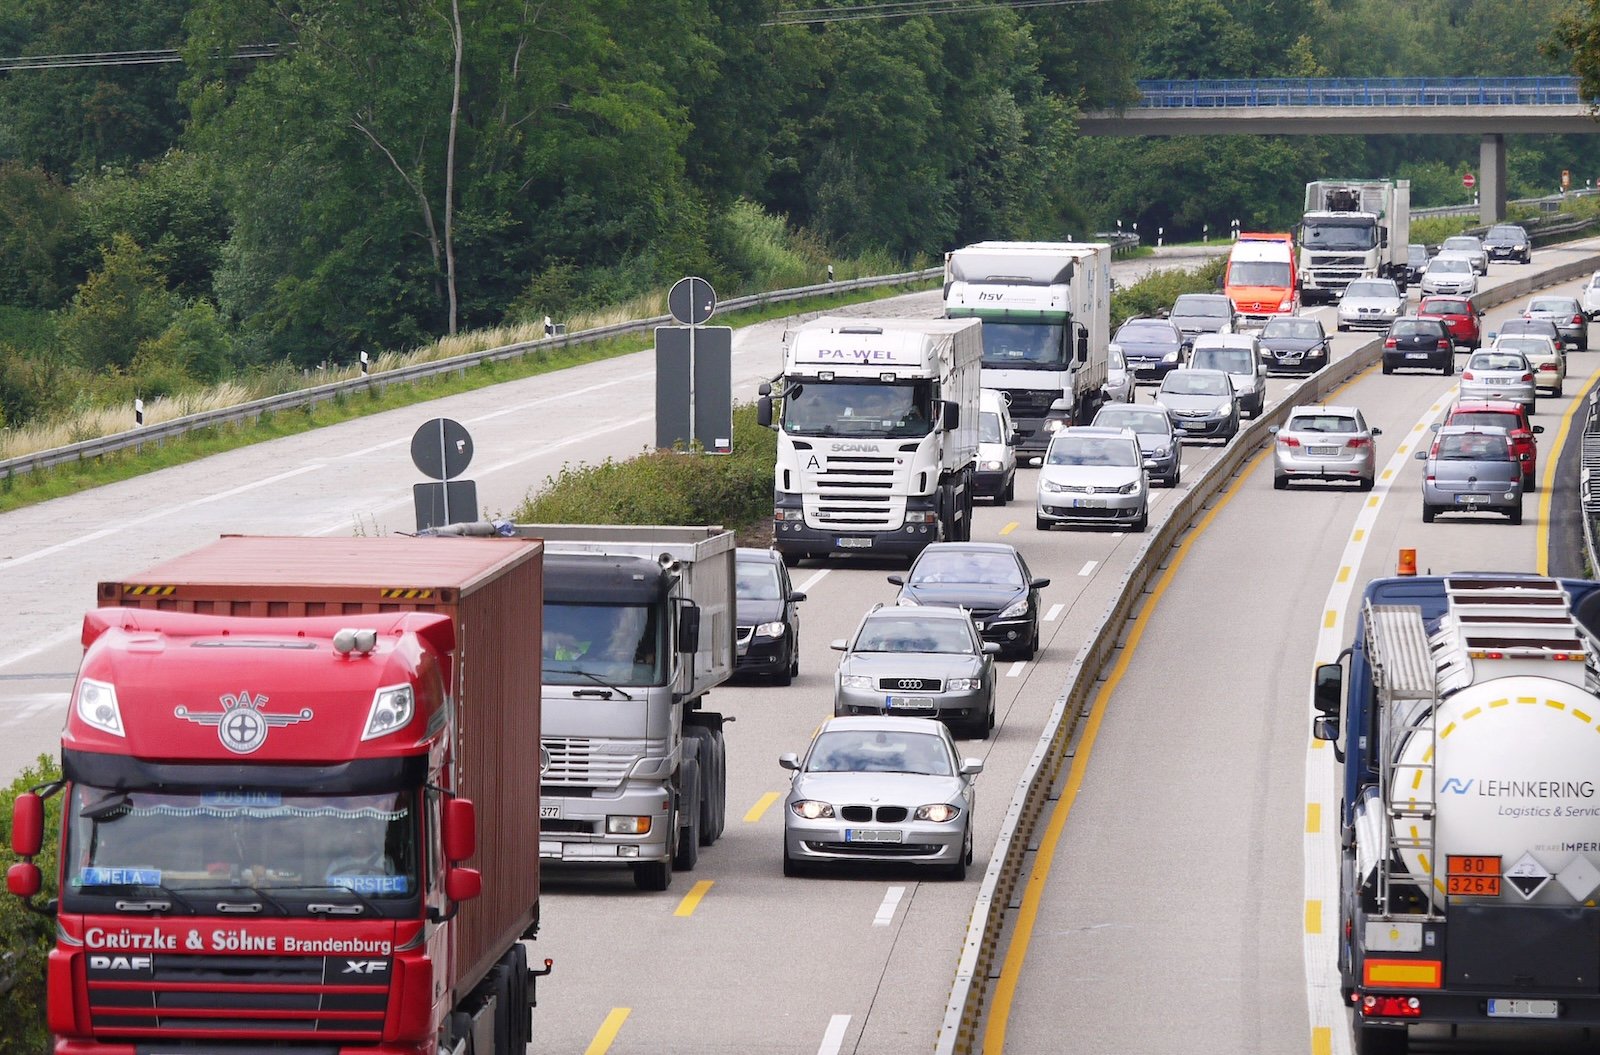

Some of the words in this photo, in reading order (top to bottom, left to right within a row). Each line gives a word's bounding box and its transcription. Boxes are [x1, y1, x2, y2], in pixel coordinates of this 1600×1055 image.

[979, 291, 1003, 301] hsv
[818, 349, 896, 360] PA-WEL
[831, 443, 880, 452] SCANIA
[807, 455, 820, 469] A
[219, 690, 269, 712] DAF
[1479, 780, 1595, 798] LEHNKERING
[540, 807, 559, 817] 377
[1498, 805, 1551, 819] Logistics
[1553, 806, 1563, 817] &
[1463, 859, 1485, 872] 80
[99, 868, 142, 885] MELA
[1451, 878, 1496, 892] 3264
[185, 928, 204, 950] &
[284, 937, 391, 955] Brandenburg
[90, 956, 150, 970] DAF
[341, 961, 388, 974] XF
